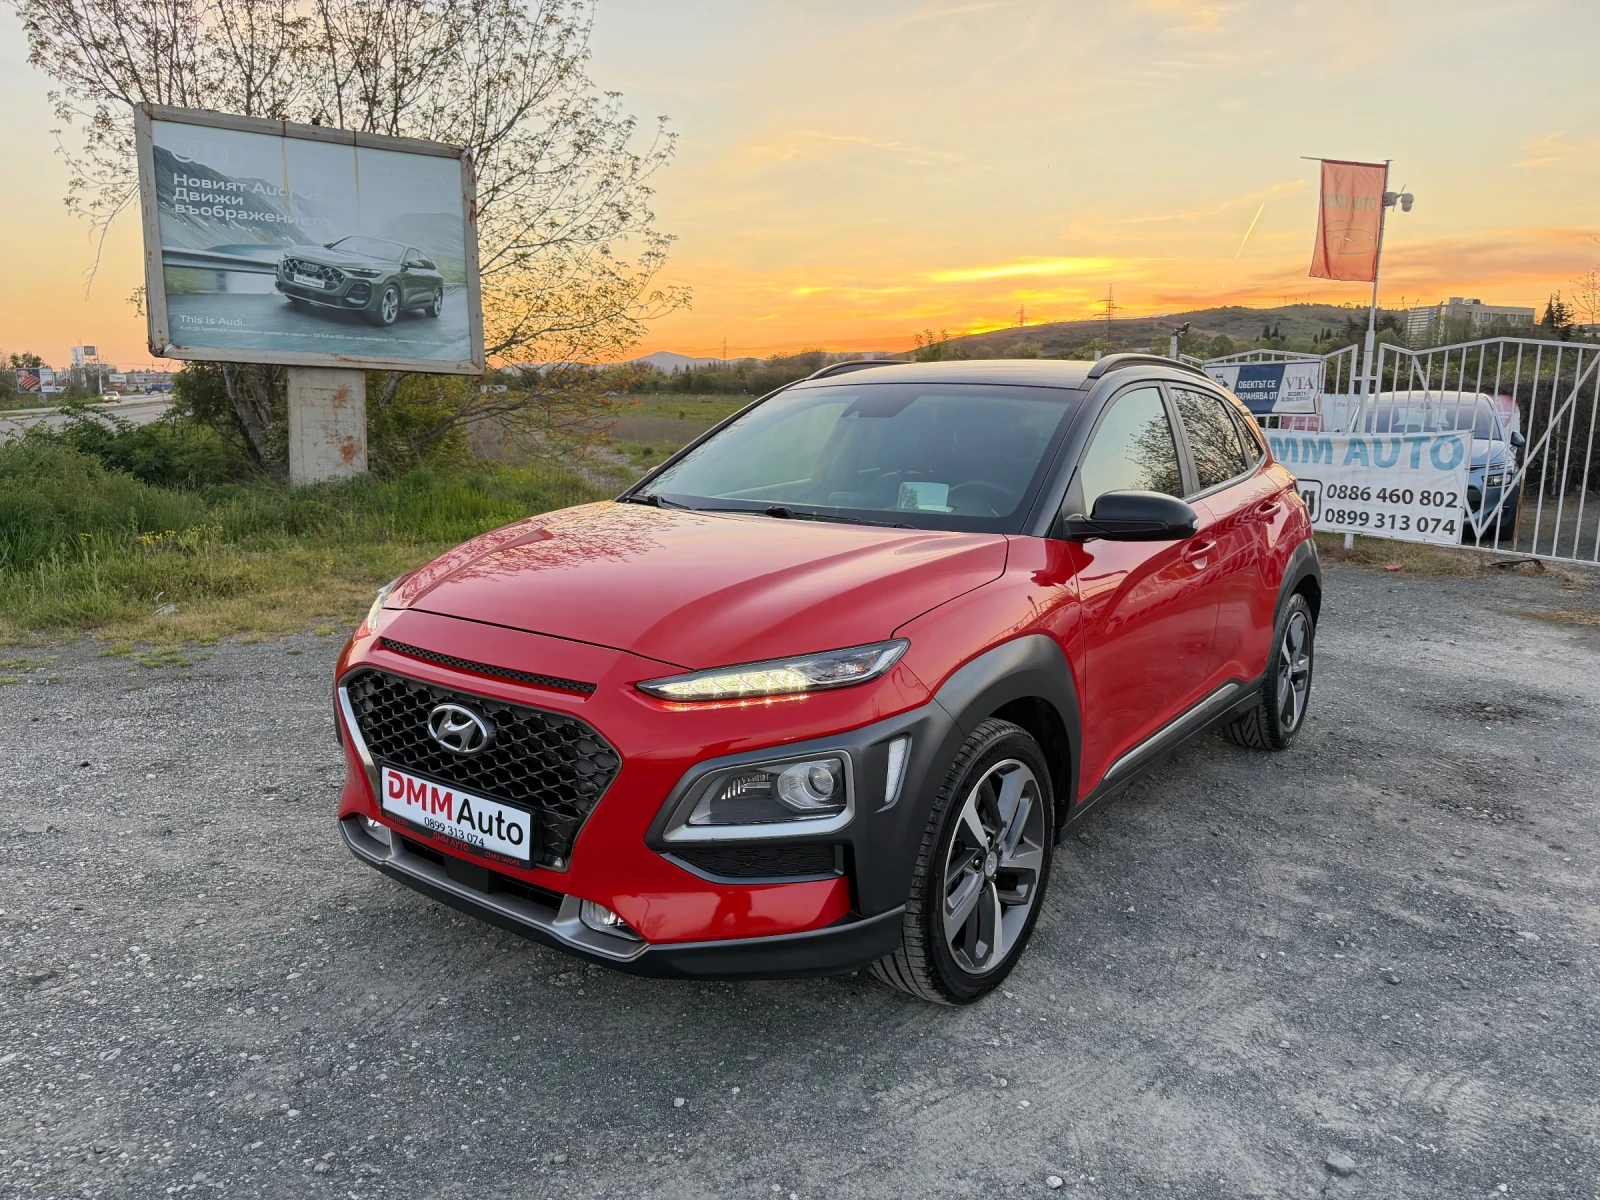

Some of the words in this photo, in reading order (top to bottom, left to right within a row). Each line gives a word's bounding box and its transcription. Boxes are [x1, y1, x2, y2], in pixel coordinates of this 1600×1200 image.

[173, 172, 247, 193] Новият
[172, 186, 244, 207] Движи
[179, 313, 203, 325] This
[205, 315, 215, 326] is
[218, 315, 247, 328] Audi.
[1238, 379, 1267, 390] ОБЕКТЪТ
[1267, 379, 1277, 389] СЕ
[1285, 376, 1316, 391] VTA
[1235, 391, 1268, 401] ОХРАНЯВА
[1269, 391, 1279, 400] ОТ
[1270, 436, 1333, 465] MM
[1343, 435, 1465, 471] AUTO
[1326, 484, 1372, 502] 0886
[1376, 487, 1414, 505] 460
[1419, 489, 1458, 510] 802
[1324, 508, 1370, 527] 0899
[1374, 512, 1410, 531] 313
[1416, 516, 1456, 536] 074
[424, 816, 446, 832] 0899
[447, 826, 464, 840] 313
[466, 832, 485, 847] 074
